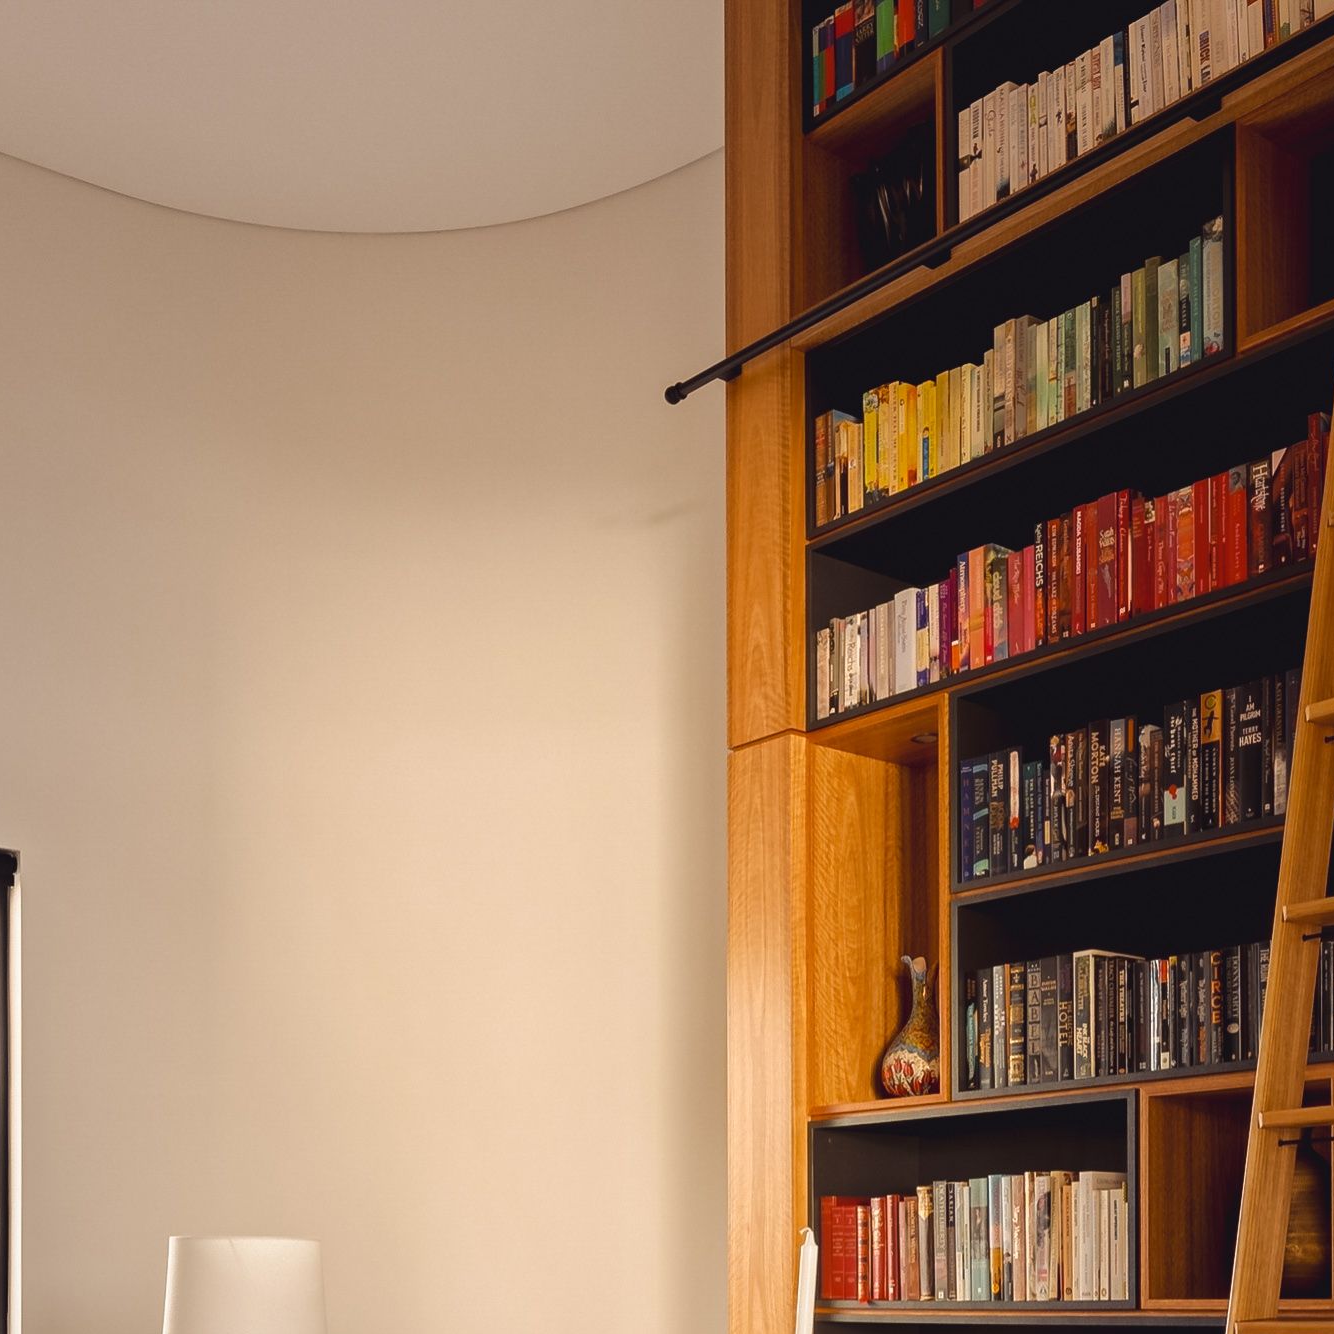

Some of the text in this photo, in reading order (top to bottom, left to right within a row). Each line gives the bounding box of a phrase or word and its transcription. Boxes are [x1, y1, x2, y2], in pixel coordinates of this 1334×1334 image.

[1199, 30, 1211, 62] BRICK
[1250, 462, 1270, 512] Heartstone
[1035, 544, 1043, 587] REICHS
[847, 642, 856, 671] Reichs
[1239, 709, 1261, 722] PILGRIM
[1245, 702, 1255, 712] AM
[1238, 732, 1262, 748] HAYES
[1242, 725, 1259, 735] TERRY
[1067, 735, 1075, 787] Anita Shreve
[1090, 732, 1099, 785] MORTON
[1098, 744, 1106, 768] KATE
[1113, 727, 1121, 804] HANNAH KENT
[1191, 757, 1199, 801] MOHAMMED
[1211, 951, 1221, 1025] CIRCE
[1028, 974, 1041, 1054] BABEL
[1058, 1001, 1068, 1048] HOTEL
